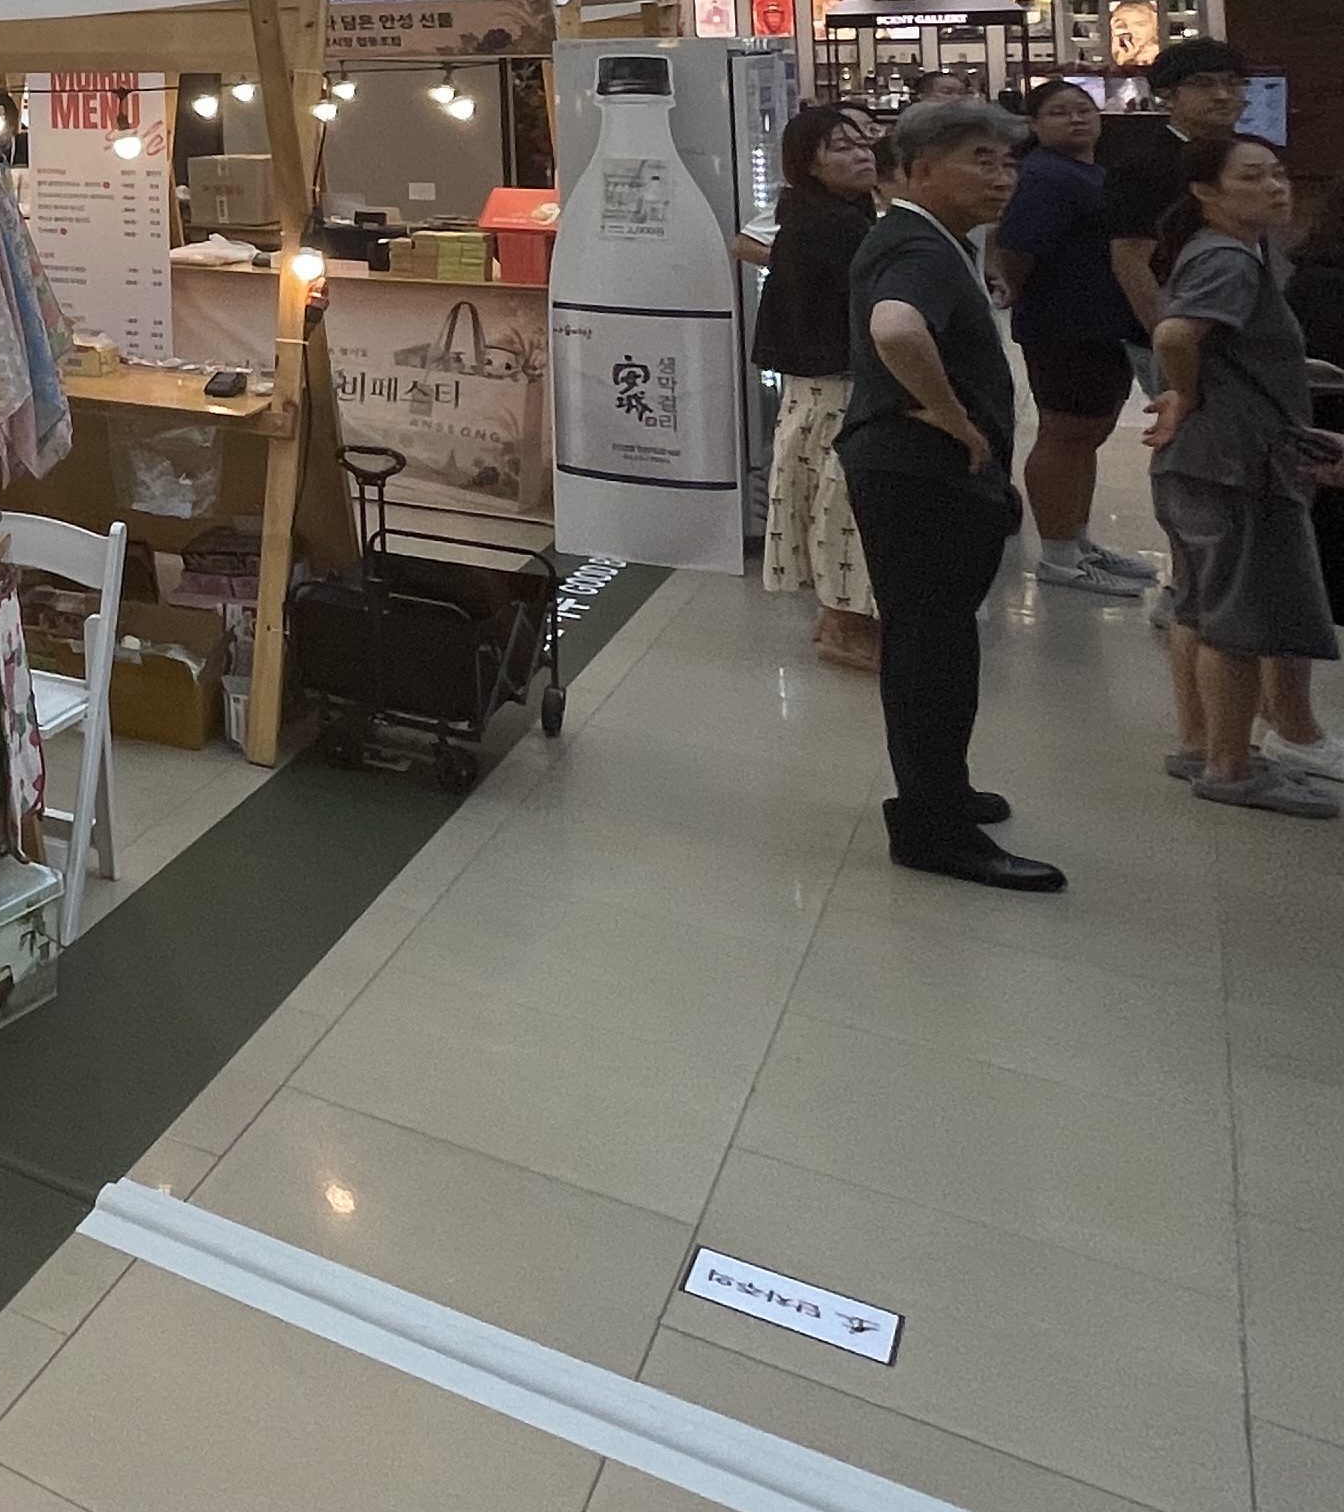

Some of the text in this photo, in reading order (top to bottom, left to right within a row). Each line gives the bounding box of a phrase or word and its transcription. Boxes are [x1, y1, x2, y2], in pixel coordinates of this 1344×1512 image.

[379, 13, 414, 30] 안성
[419, 12, 454, 29] 선물
[51, 93, 141, 129] MENU
